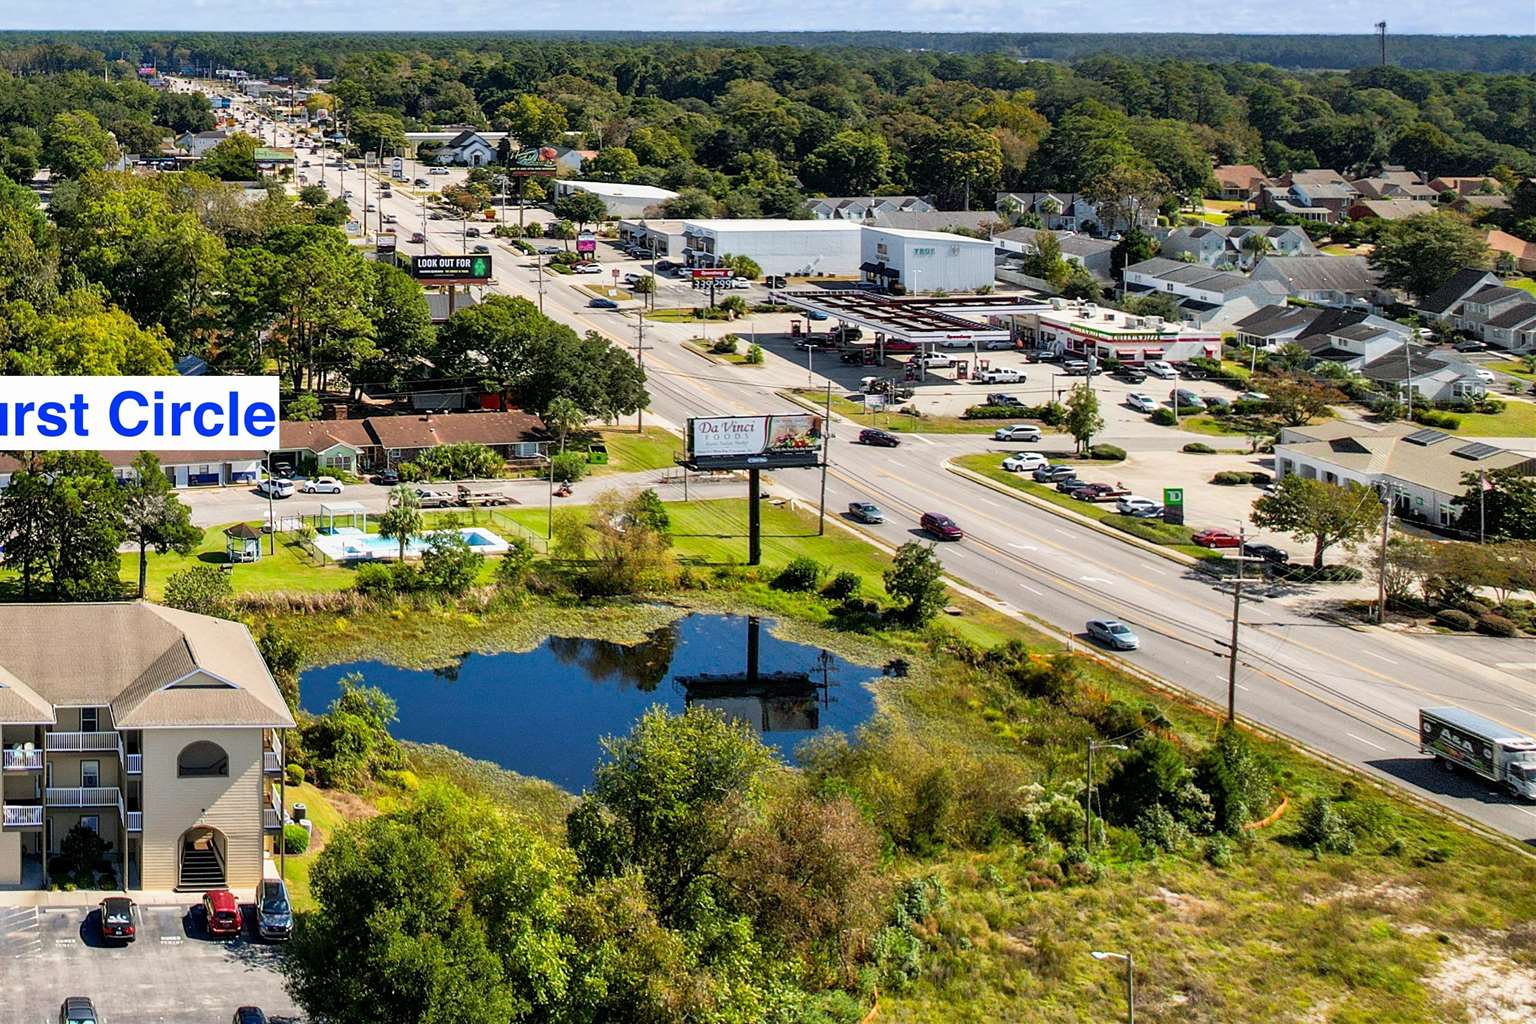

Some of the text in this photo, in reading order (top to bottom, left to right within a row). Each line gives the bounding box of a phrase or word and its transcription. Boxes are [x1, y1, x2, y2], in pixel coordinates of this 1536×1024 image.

[417, 259, 471, 267] LOOK OUT FOR
[699, 421, 754, 434] Da Vinci
